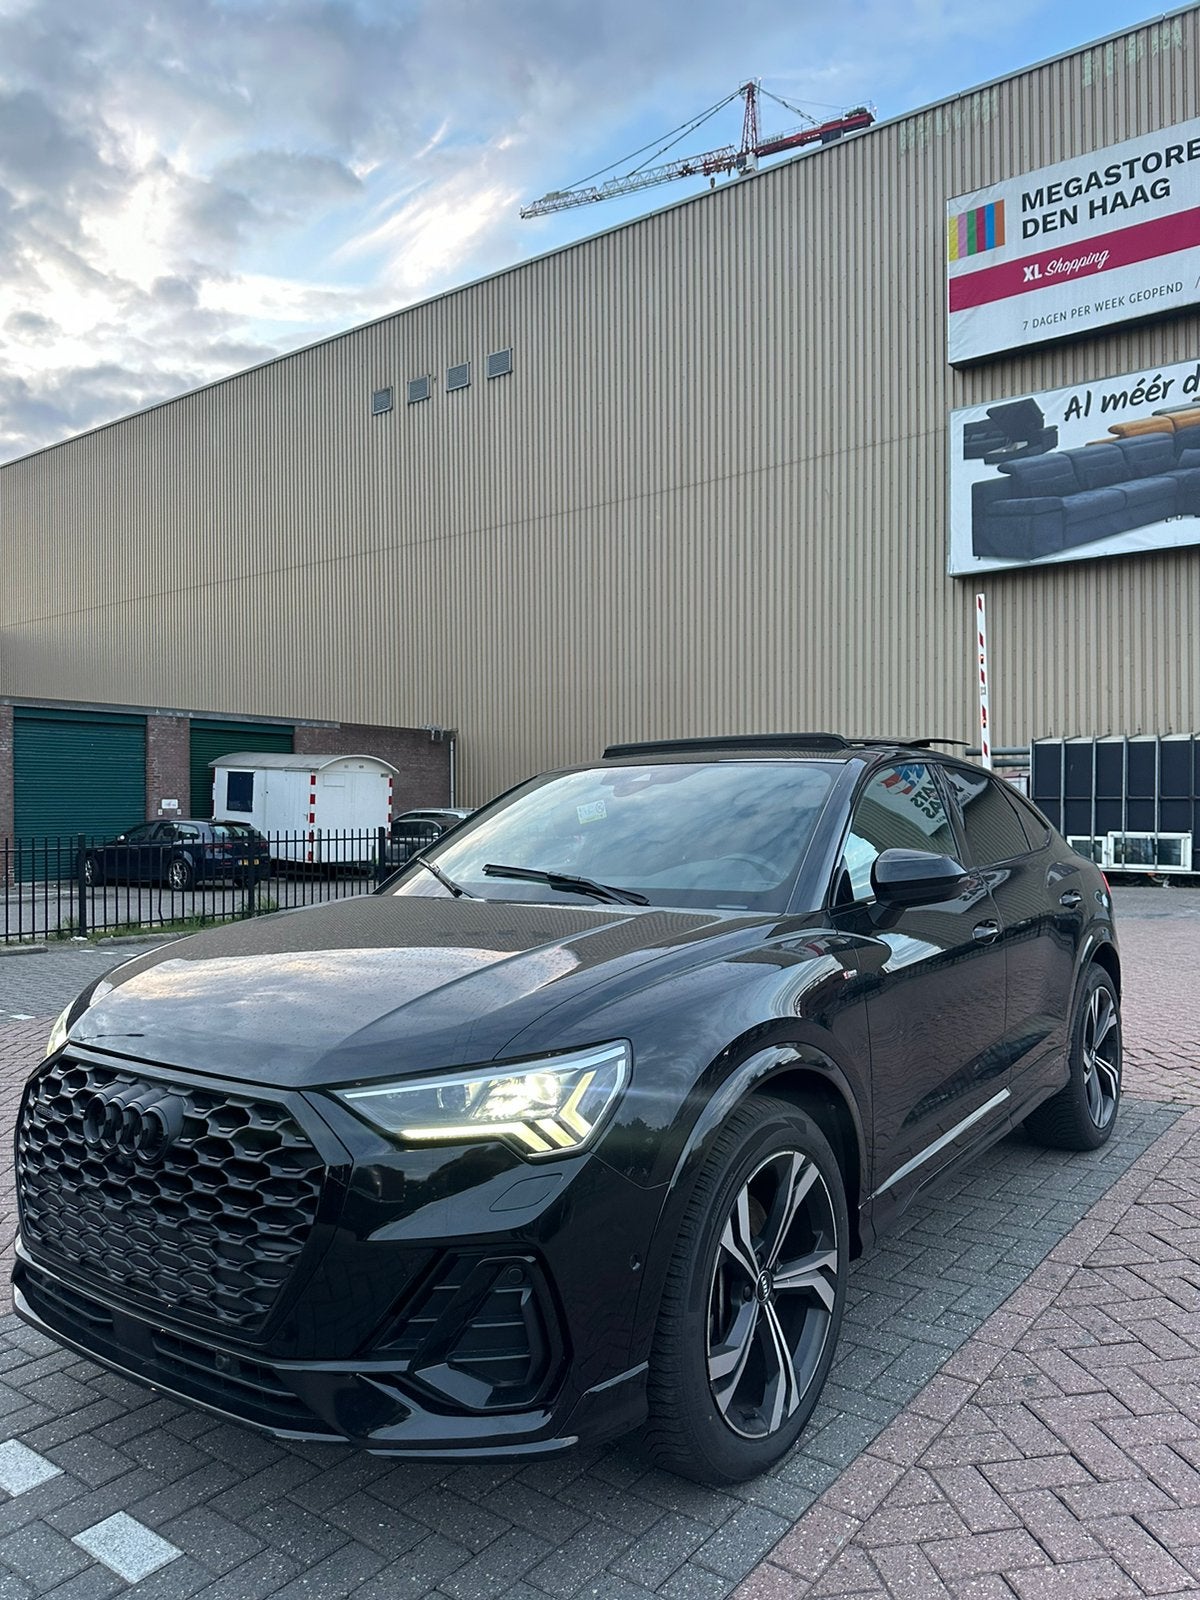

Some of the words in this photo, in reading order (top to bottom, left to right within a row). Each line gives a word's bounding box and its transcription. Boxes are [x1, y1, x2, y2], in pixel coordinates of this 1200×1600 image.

[1021, 137, 1200, 213] MEGASTORE
[1022, 204, 1078, 240] DEN
[1088, 177, 1171, 220] HAAG
[1023, 263, 1043, 283] XL
[1044, 249, 1110, 277] Shopping
[1023, 320, 1029, 331] 7
[1032, 310, 1067, 329] DAGEN
[1070, 304, 1091, 319] PER
[1094, 295, 1125, 312] WEEK
[1128, 281, 1183, 304] GEOPEND
[1063, 389, 1092, 422] Al
[1100, 373, 1176, 414] méér
